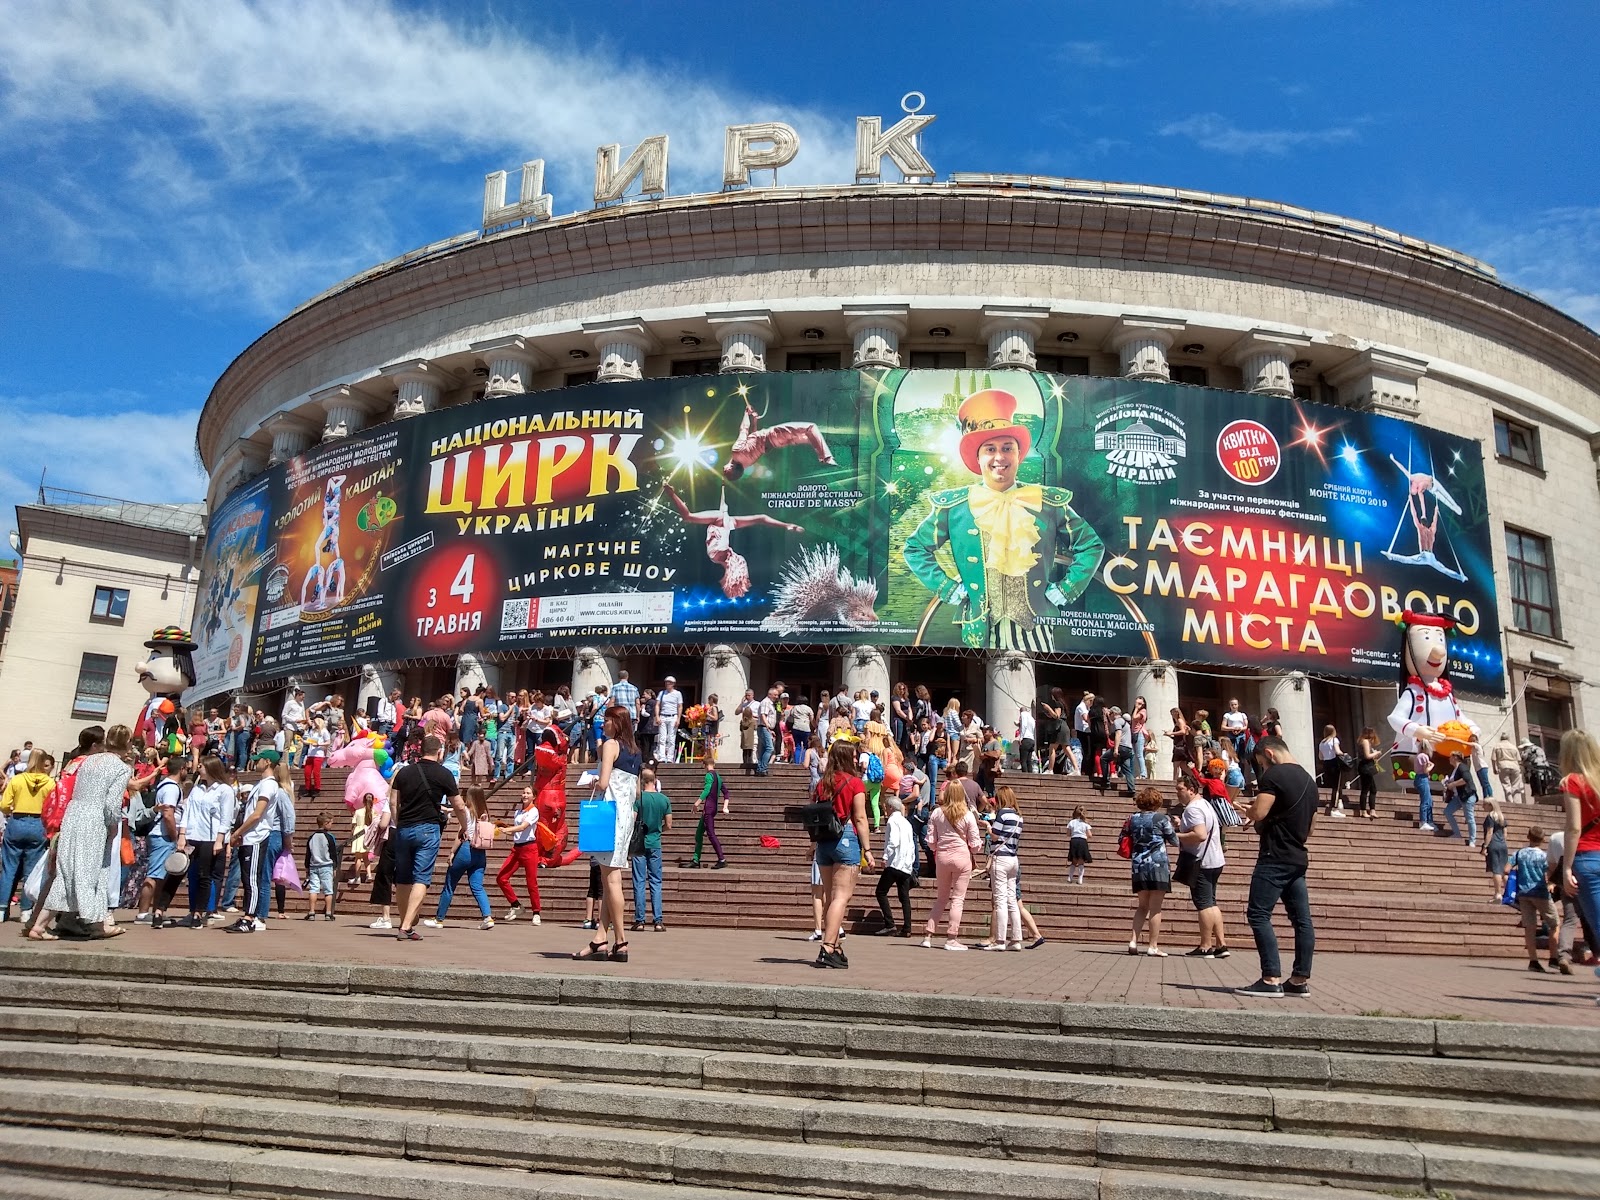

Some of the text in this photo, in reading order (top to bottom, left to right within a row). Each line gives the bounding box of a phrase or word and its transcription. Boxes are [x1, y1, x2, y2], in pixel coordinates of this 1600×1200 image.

[482, 113, 936, 229] ЦИРК
[1136, 403, 1163, 412] КУЛЬТУРИ
[1164, 410, 1184, 426] УКРАЇНИ
[430, 408, 644, 457] НАЦІОНАЛЬНИЙ
[1222, 428, 1268, 450] КВИТКИ
[284, 438, 398, 484] КИЇВСЬКИЙ МІЖНАРОДНИЙ МОЛОДІЖНИЙ
[1106, 450, 1178, 468] ЦИРК
[1238, 446, 1260, 458] ВІД
[287, 450, 391, 490] ФЕСТИВАЛЬ ЦИРКОВОГО МИСТЕЦТВА
[424, 433, 644, 515] ЦИРК
[1106, 462, 1176, 480] УКРАЇНИ
[1232, 456, 1277, 480] 100 ГРН
[761, 491, 816, 499] МІЖНАРОДНИЙ
[1198, 490, 1300, 508] За участю переможців
[1309, 488, 1388, 508] МОНТЕ КАРЛО 2019
[1324, 483, 1372, 496] СРІБНИЙ КЛОУН
[768, 498, 857, 508] CIRQUE DE MASSY
[1170, 498, 1327, 522] міжнародних циркових фестивалів
[456, 503, 595, 536] УКРАЇНИ
[408, 536, 430, 550] ЦИРКОВА
[544, 540, 641, 560] МАГІЧНЕ
[1122, 515, 1364, 577] ТАЄМНИЦІ
[450, 553, 475, 604] 4
[508, 562, 677, 592] ЦИРКОВЕ ШОУ
[1103, 557, 1480, 636] СМАРАГДОВОГО
[358, 612, 375, 625] ВХІД
[580, 609, 642, 617] WWW.CIRCUS.KIEV.UA
[1060, 610, 1126, 620] ПОЧЕСНА НАГОРОДА
[351, 618, 382, 638] ВІЛЬНИЙ
[416, 611, 482, 637] ТРАВНЯ
[550, 624, 668, 638] www.circus.kiev.ua
[1106, 620, 1155, 632] MAGICIANS
[1182, 607, 1327, 656] МІСТА
[256, 636, 264, 646] 30
[499, 633, 518, 642] Деталі
[1351, 648, 1390, 659] Call-center:
[1452, 660, 1462, 670] 93
[1464, 662, 1474, 672] 93
